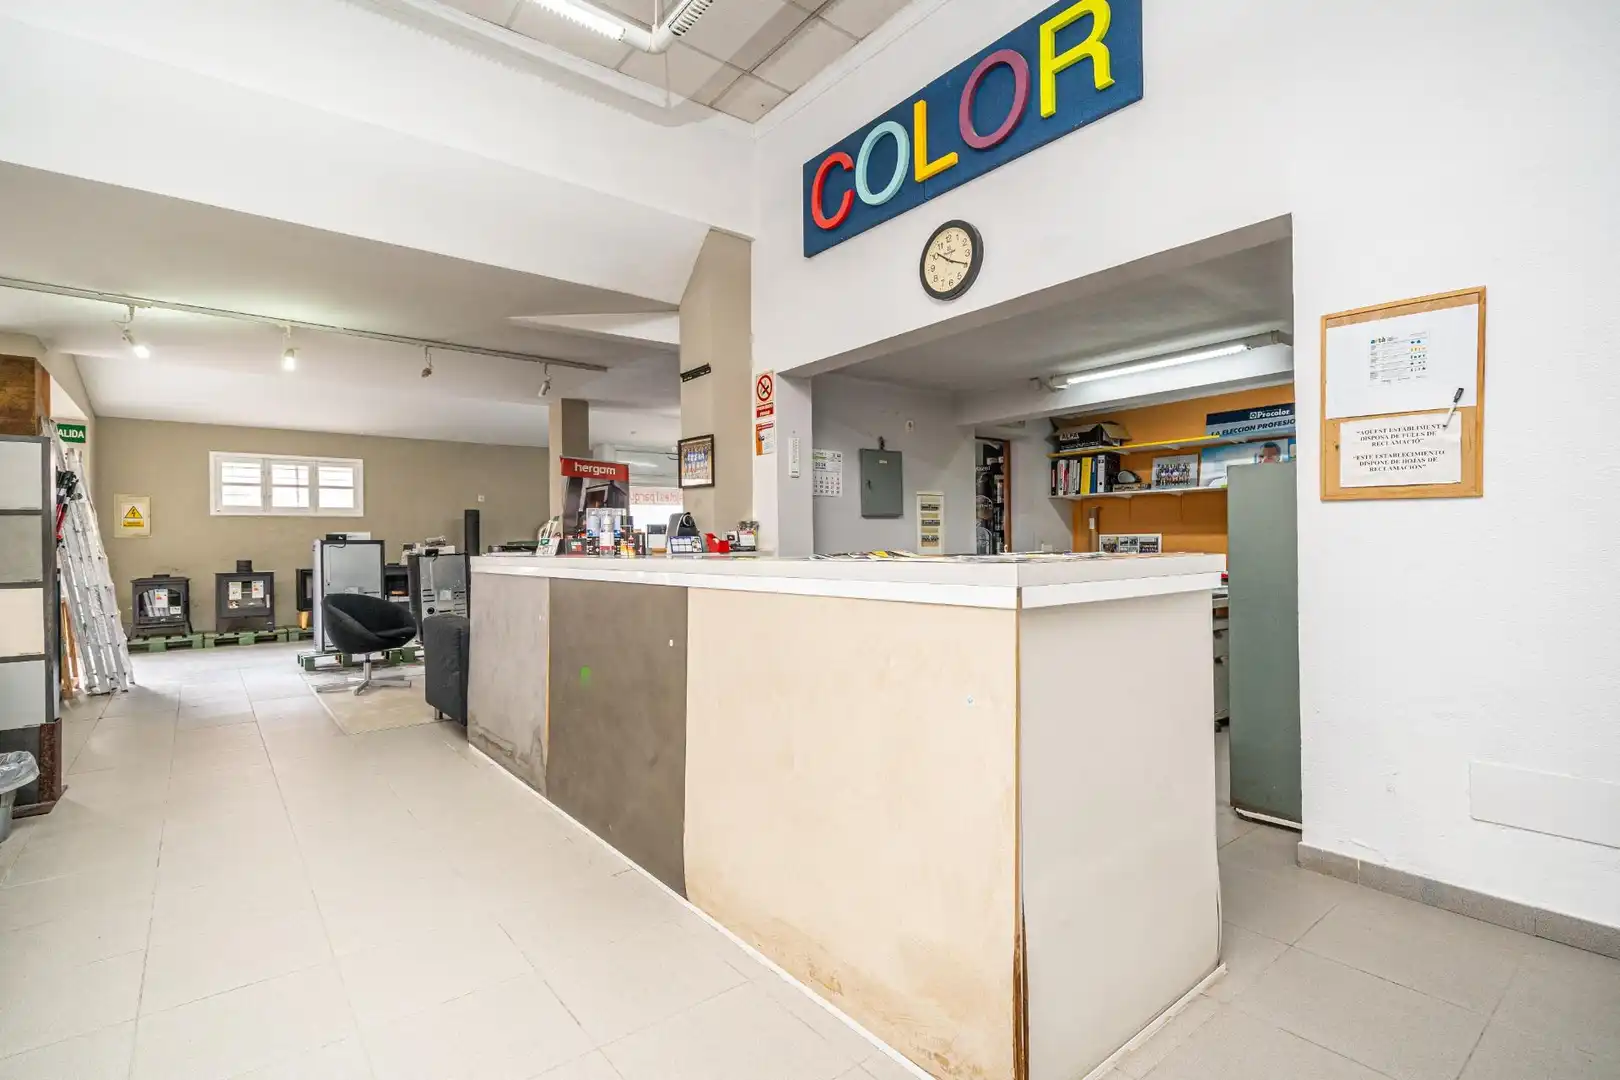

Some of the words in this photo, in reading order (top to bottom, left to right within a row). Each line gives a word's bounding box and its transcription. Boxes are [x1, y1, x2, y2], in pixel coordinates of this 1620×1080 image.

[811, 0, 1115, 230] COLOR
[1257, 409, 1290, 418] Procolor
[1222, 425, 1256, 435] ELECCION
[1389, 424, 1441, 433] ESTABLIMENT
[57, 429, 84, 438] ALIDA
[1375, 450, 1445, 459] ESTABLECIMIENTO
